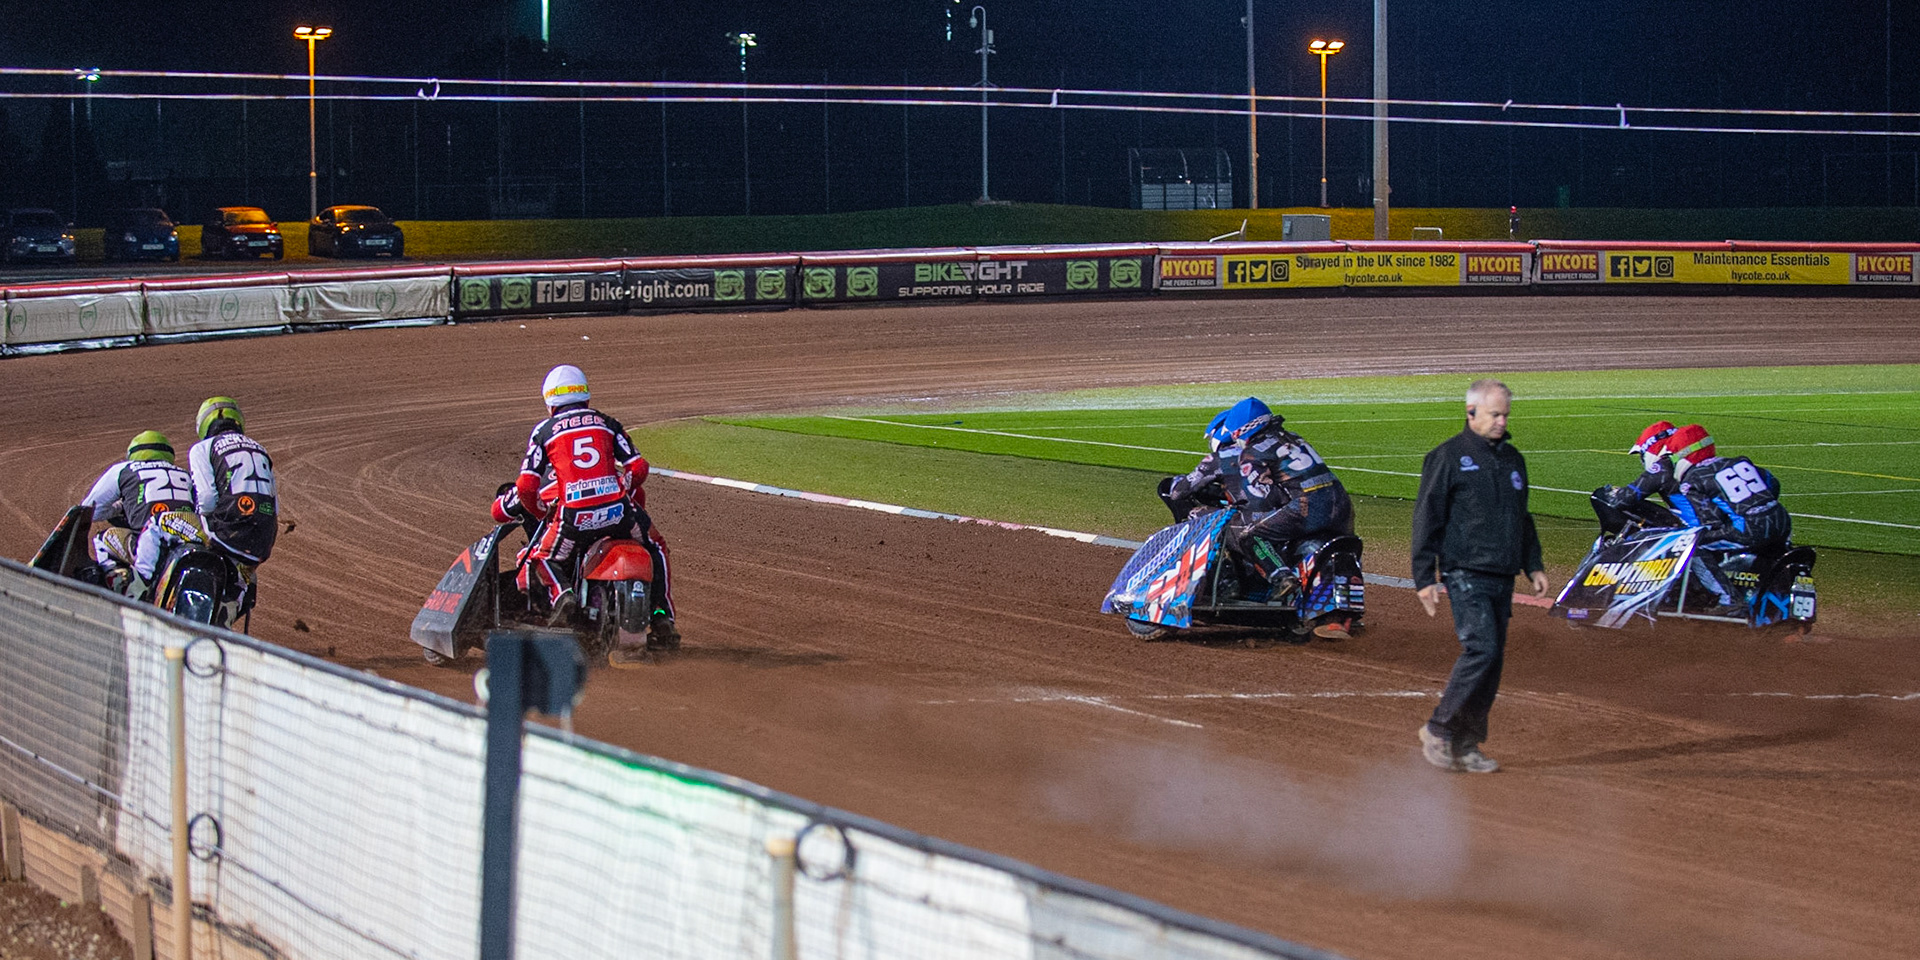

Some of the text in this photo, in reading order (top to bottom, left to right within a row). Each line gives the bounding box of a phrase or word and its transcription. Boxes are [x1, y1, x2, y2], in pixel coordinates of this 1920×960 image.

[1296, 255, 1455, 269] Sprayed in the UK since 1982
[1468, 257, 1521, 272] HYCOTE
[1542, 254, 1597, 270] HYCOTE
[1693, 253, 1830, 266] Maintenance Essentials
[1858, 256, 1911, 272] HYCOTE
[915, 261, 1028, 282] BIKERIGHT
[1162, 260, 1215, 276] HYCOTE
[1731, 270, 1791, 282] hycote.co.uk
[1162, 279, 1173, 287] THE
[1344, 273, 1403, 285] hycote.co.uk
[590, 279, 709, 303] bike-right.com
[898, 283, 1045, 297] SUPPORTING YOUR RIDE
[573, 436, 601, 469] 5
[224, 450, 275, 495] 29
[138, 468, 194, 503] 29
[1715, 460, 1768, 503] 69
[1671, 534, 1697, 553] 69
[1734, 571, 1760, 582] LOOK
[1793, 596, 1816, 618] 69
